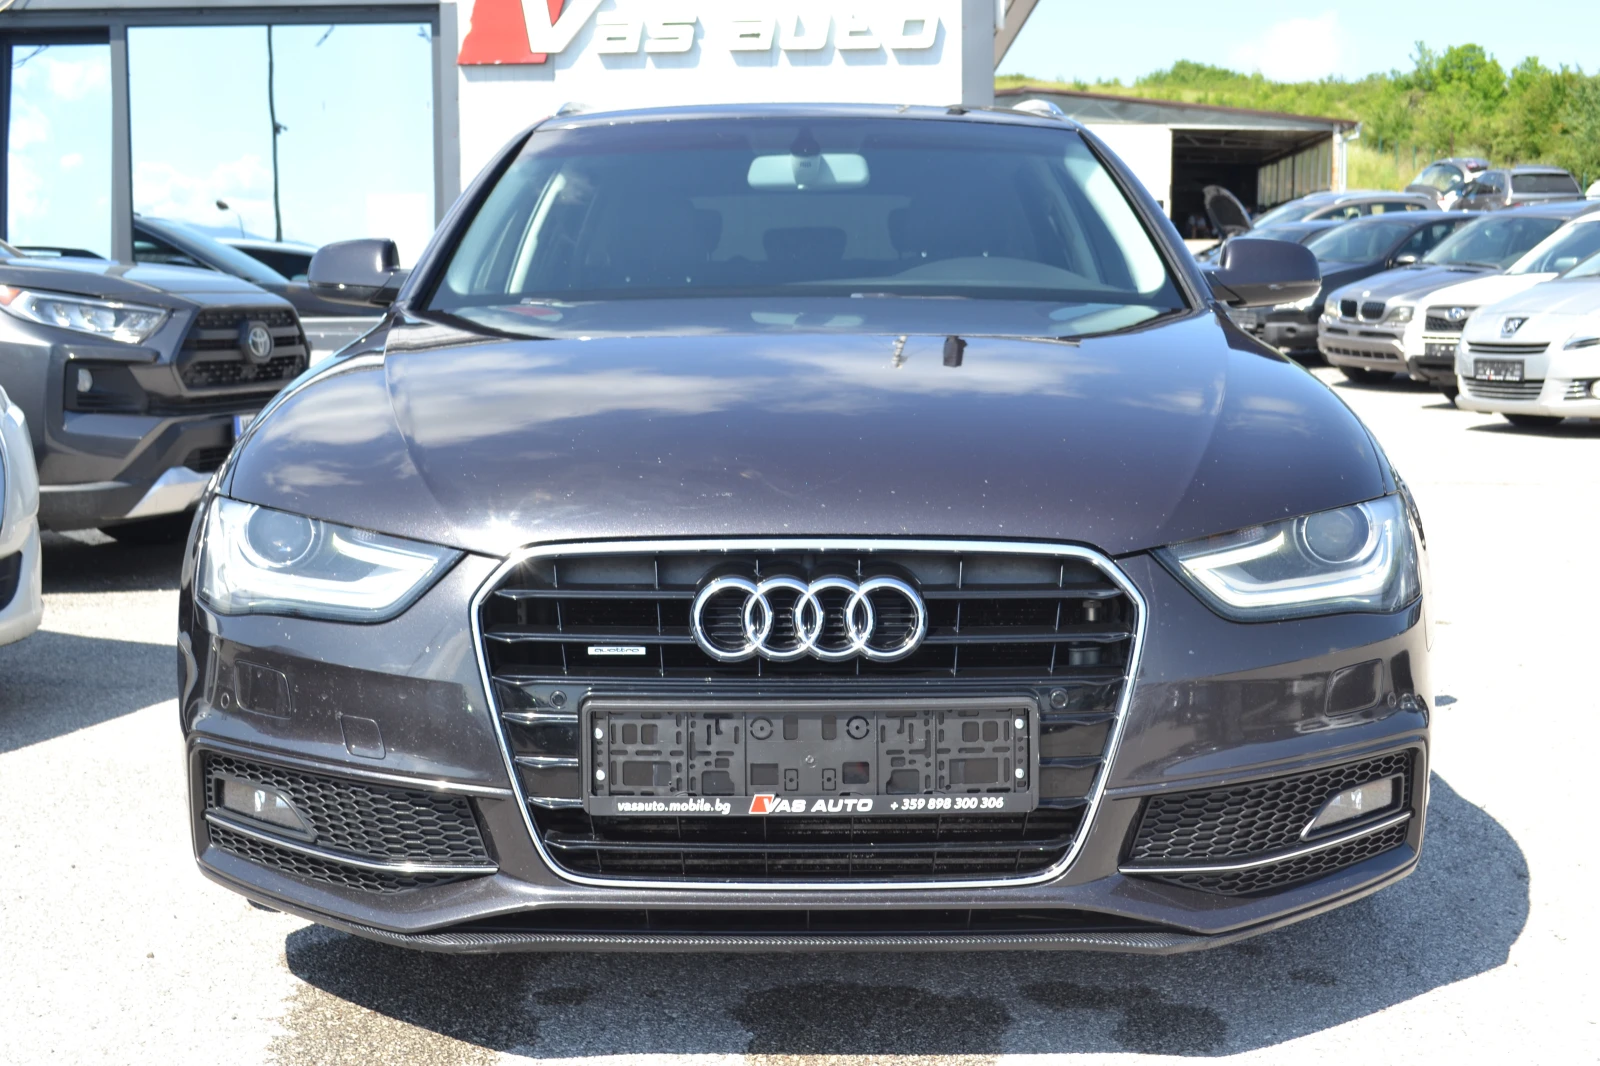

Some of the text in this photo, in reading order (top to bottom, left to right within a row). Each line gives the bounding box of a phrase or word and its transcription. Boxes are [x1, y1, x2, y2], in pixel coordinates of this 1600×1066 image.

[728, 10, 940, 51] auto
[617, 798, 731, 814] vasauto.mobile.bg
[763, 797, 873, 813] VAS AUTO
[901, 798, 925, 810] 359
[927, 797, 952, 810] 898
[953, 796, 978, 809] 300
[980, 796, 1004, 809] 306
